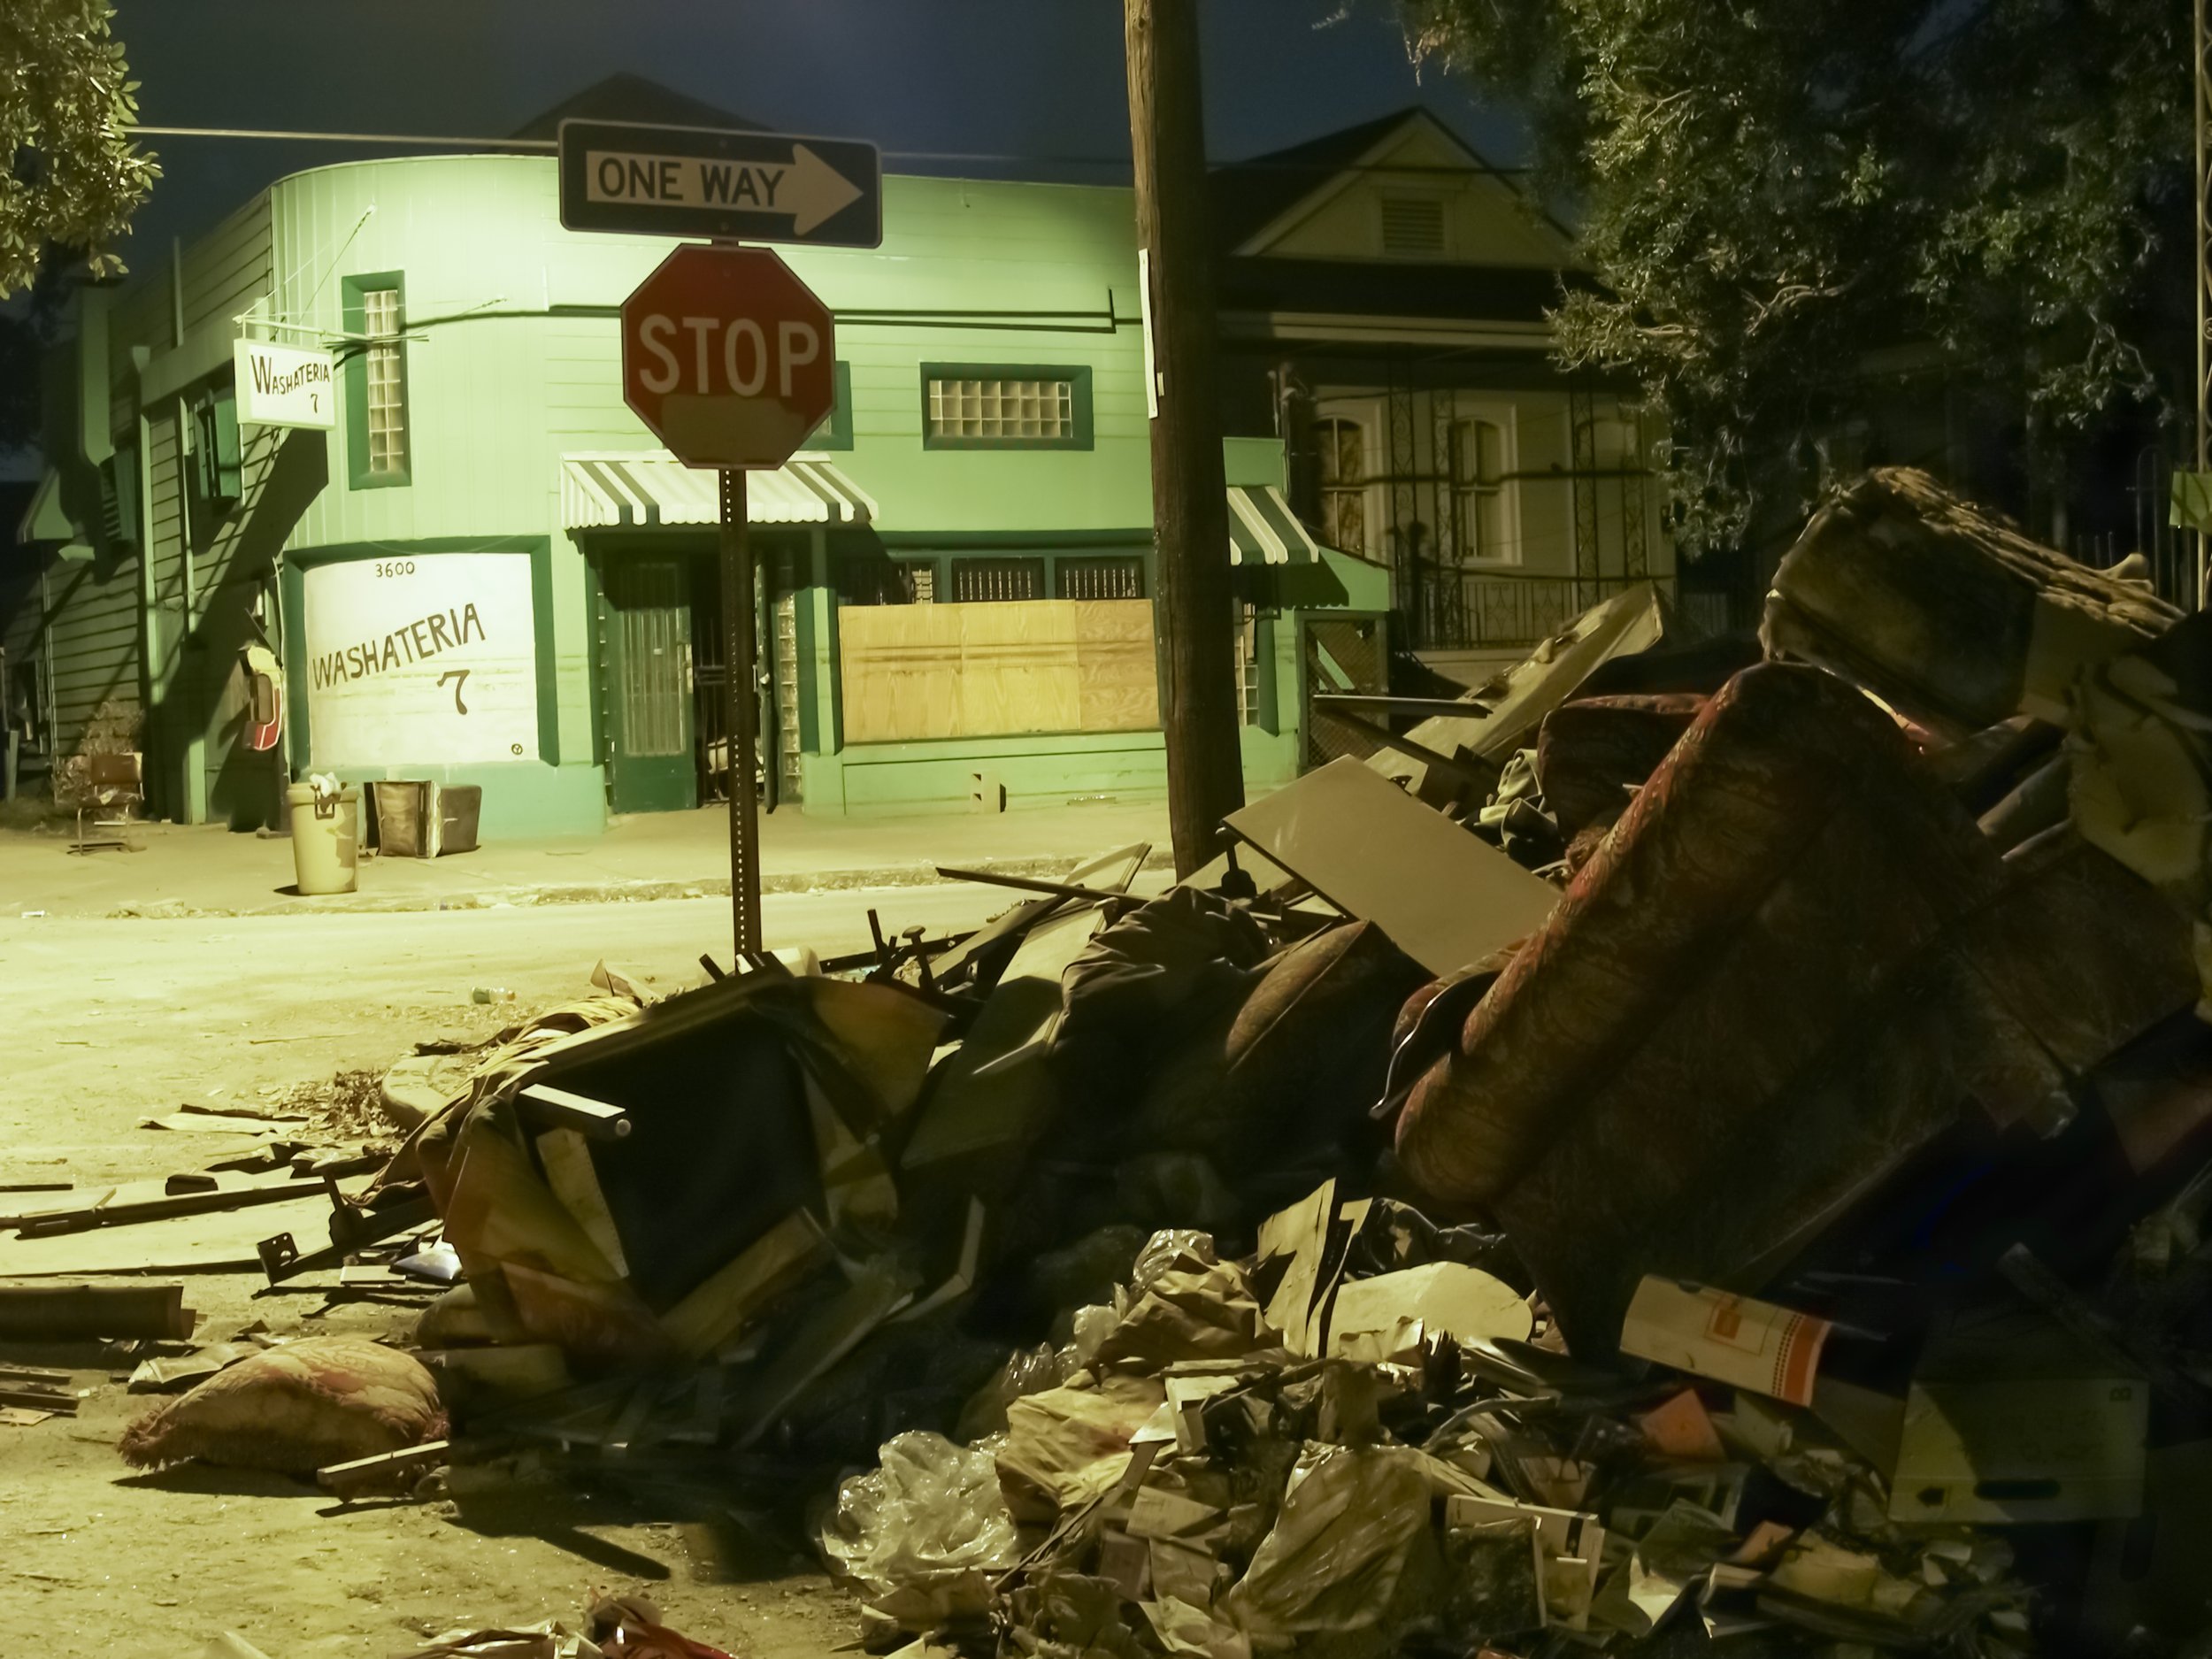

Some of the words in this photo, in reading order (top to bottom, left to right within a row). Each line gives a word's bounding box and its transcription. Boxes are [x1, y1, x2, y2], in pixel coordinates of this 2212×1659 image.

[598, 157, 684, 202] ONE
[700, 165, 786, 208] WAY
[250, 354, 330, 396] WASHATERIA
[639, 314, 820, 397] STOP
[311, 393, 319, 414] 7
[375, 561, 416, 578] 3600
[312, 603, 487, 691] WASHATERIA
[436, 669, 471, 716] 7
